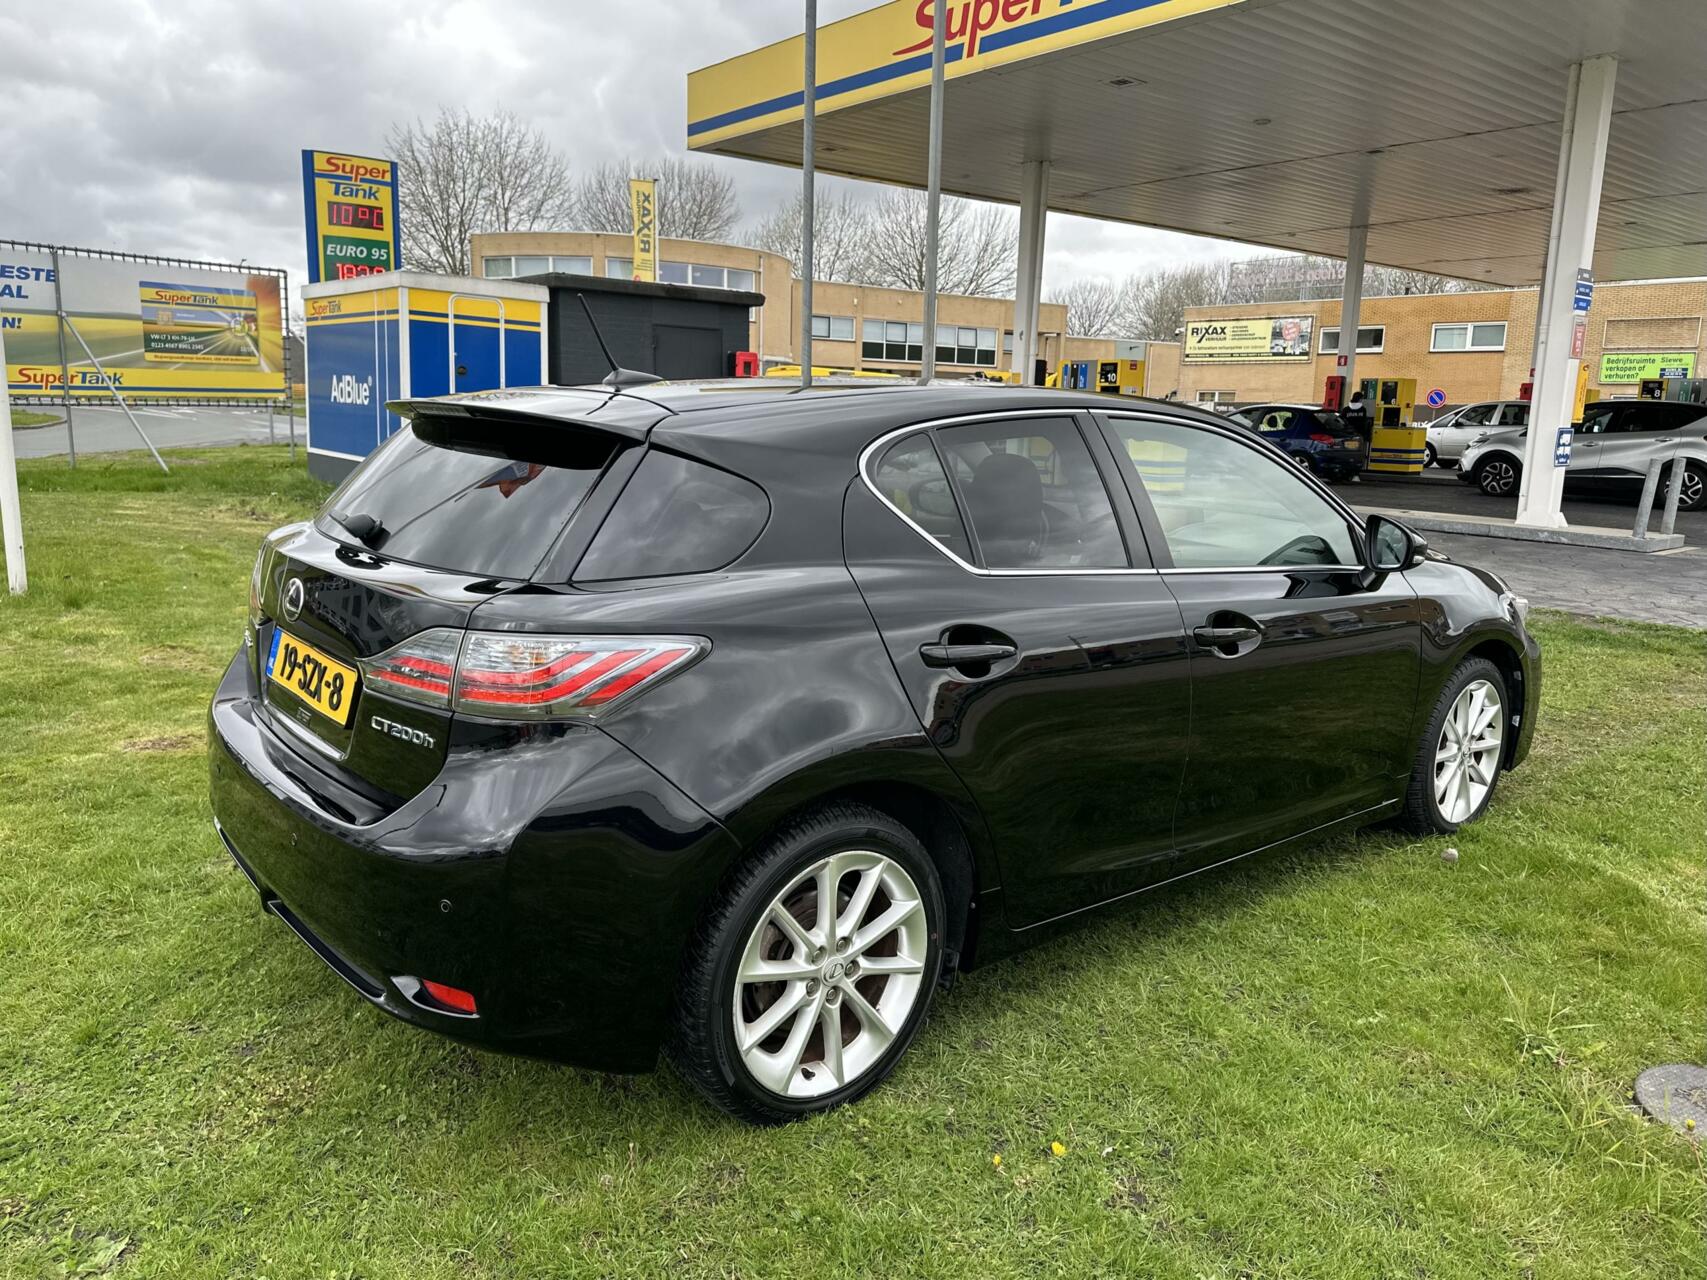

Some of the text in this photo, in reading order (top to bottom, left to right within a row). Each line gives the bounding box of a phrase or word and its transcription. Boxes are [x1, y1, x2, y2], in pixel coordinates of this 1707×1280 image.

[316, 156, 390, 182] Super
[328, 181, 380, 201] Tank
[326, 244, 388, 260] EURO 95
[0, 284, 29, 299] AL
[150, 290, 218, 306] SuperTank
[310, 300, 342, 317] SuperTank
[2, 316, 22, 329] N!
[1191, 325, 1227, 343] RIXAX
[1605, 365, 1636, 373] verkopen
[1606, 357, 1656, 366] Bedrijfsruimte
[1107, 372, 1116, 382] 10
[1654, 389, 1661, 398] 8
[279, 642, 344, 712] 19-SZX-8
[371, 715, 436, 749] CT200h
